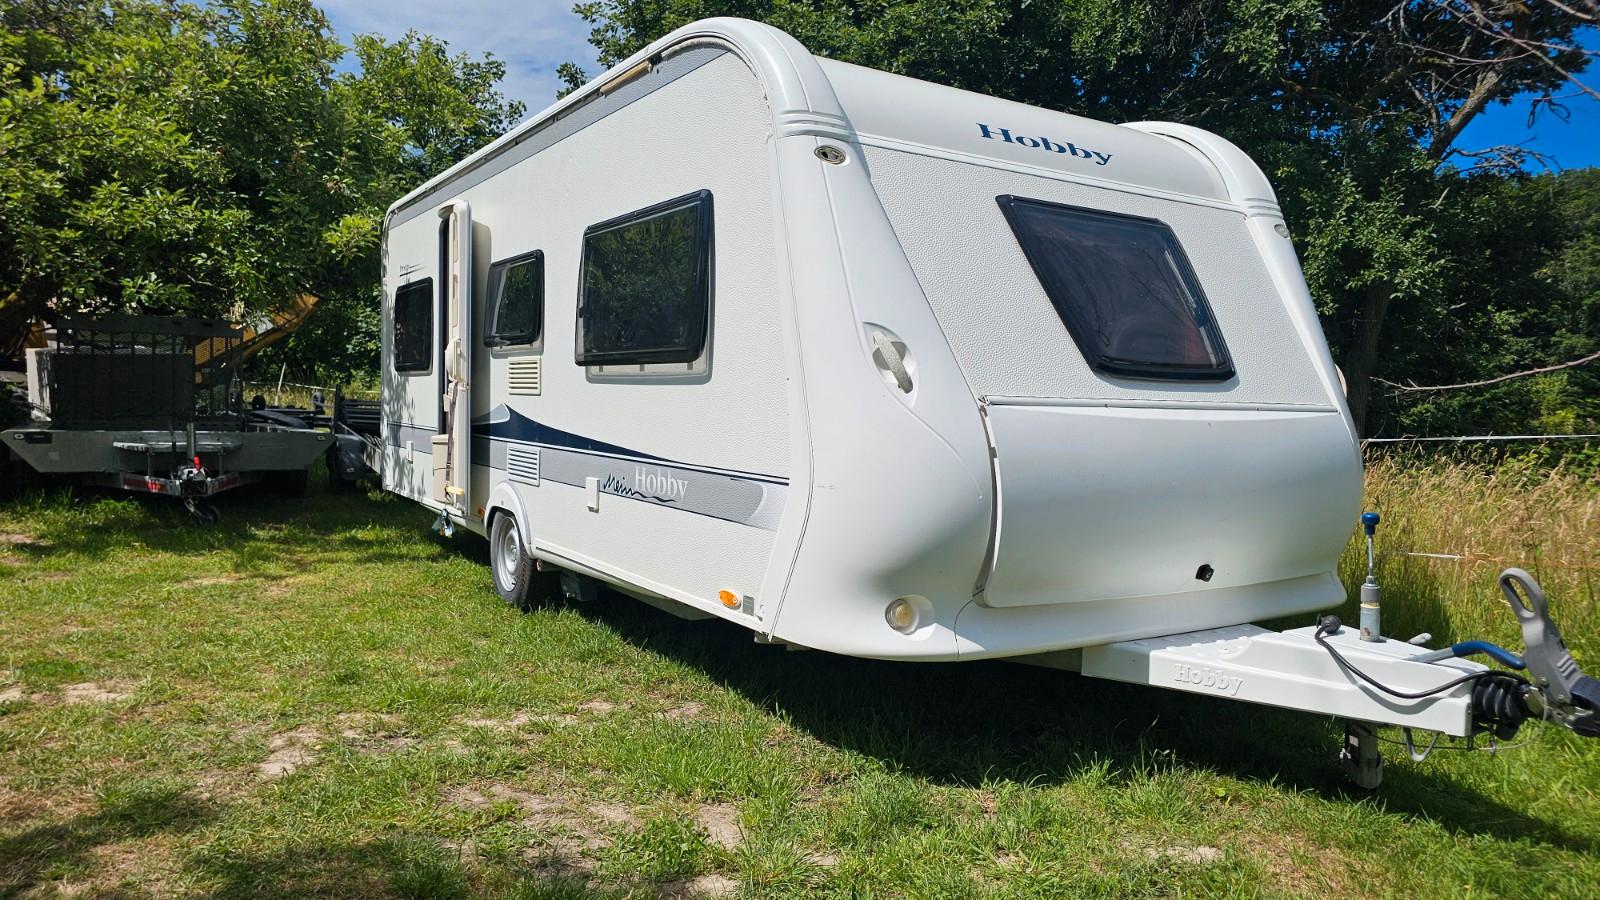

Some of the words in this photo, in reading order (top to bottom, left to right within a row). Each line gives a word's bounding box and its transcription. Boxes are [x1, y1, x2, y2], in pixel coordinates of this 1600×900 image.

[976, 123, 1112, 165] Hobby
[603, 473, 650, 498] Mein
[634, 466, 689, 502] Hobby
[1174, 664, 1243, 696] Hobby
